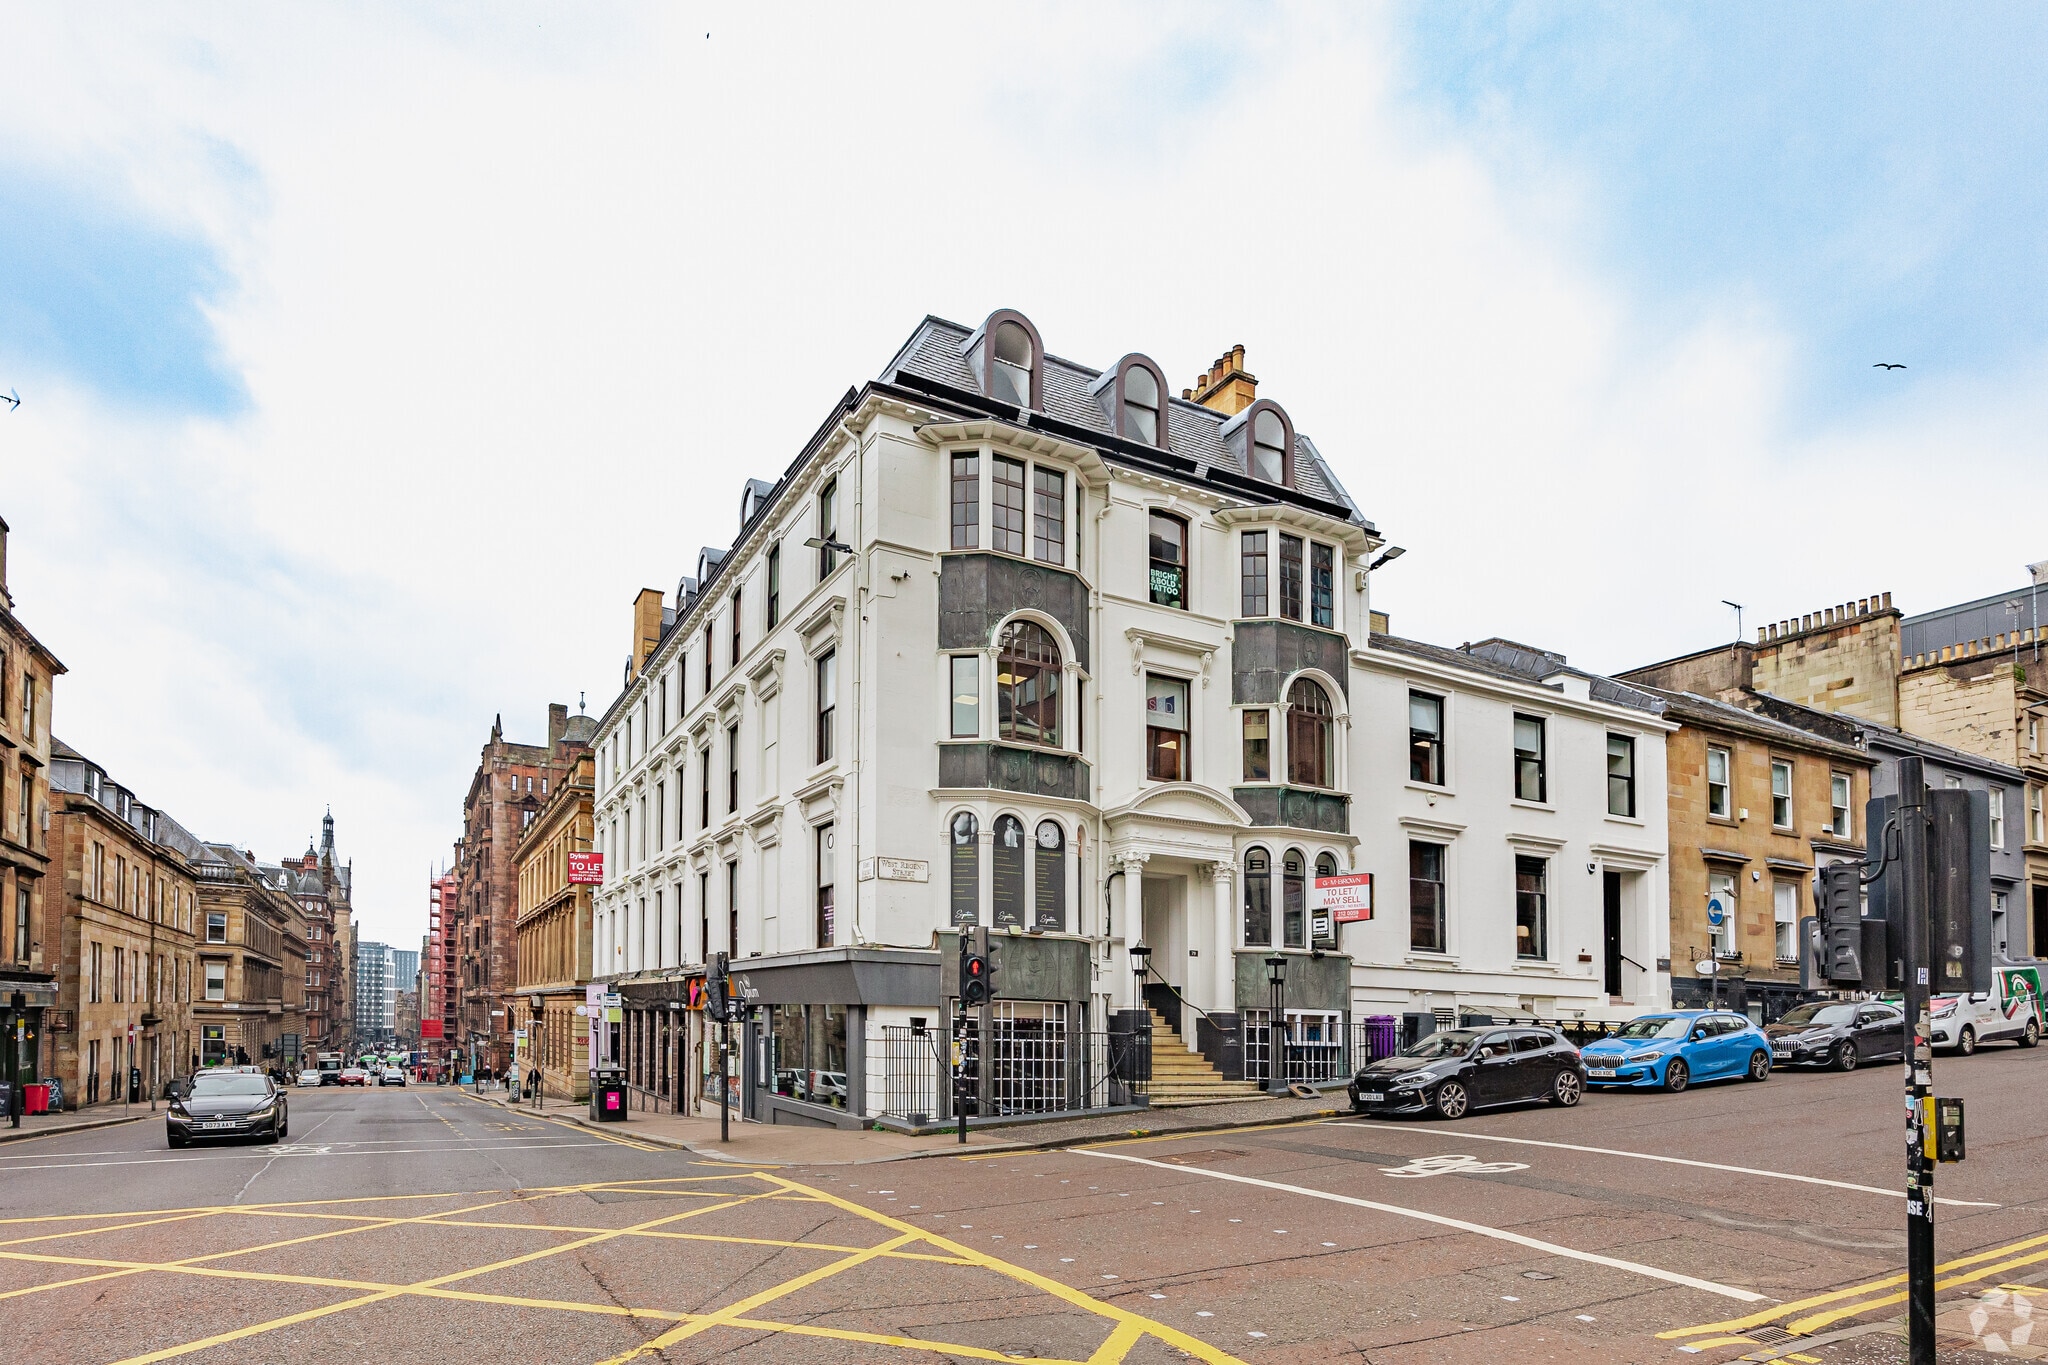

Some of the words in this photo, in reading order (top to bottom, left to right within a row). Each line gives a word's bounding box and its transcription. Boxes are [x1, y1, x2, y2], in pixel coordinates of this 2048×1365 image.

[1150, 569, 1178, 581] BRIGHT
[1150, 582, 1178, 596] TATTOO
[570, 862, 585, 870] TO
[587, 863, 603, 871] LET
[881, 859, 898, 868] WEST
[900, 862, 925, 871] REGENT
[892, 868, 915, 877] STREET
[1338, 887, 1352, 896] LET
[1354, 887, 1358, 895] /
[1342, 895, 1361, 904] SELL
[738, 980, 759, 1003] Opium
